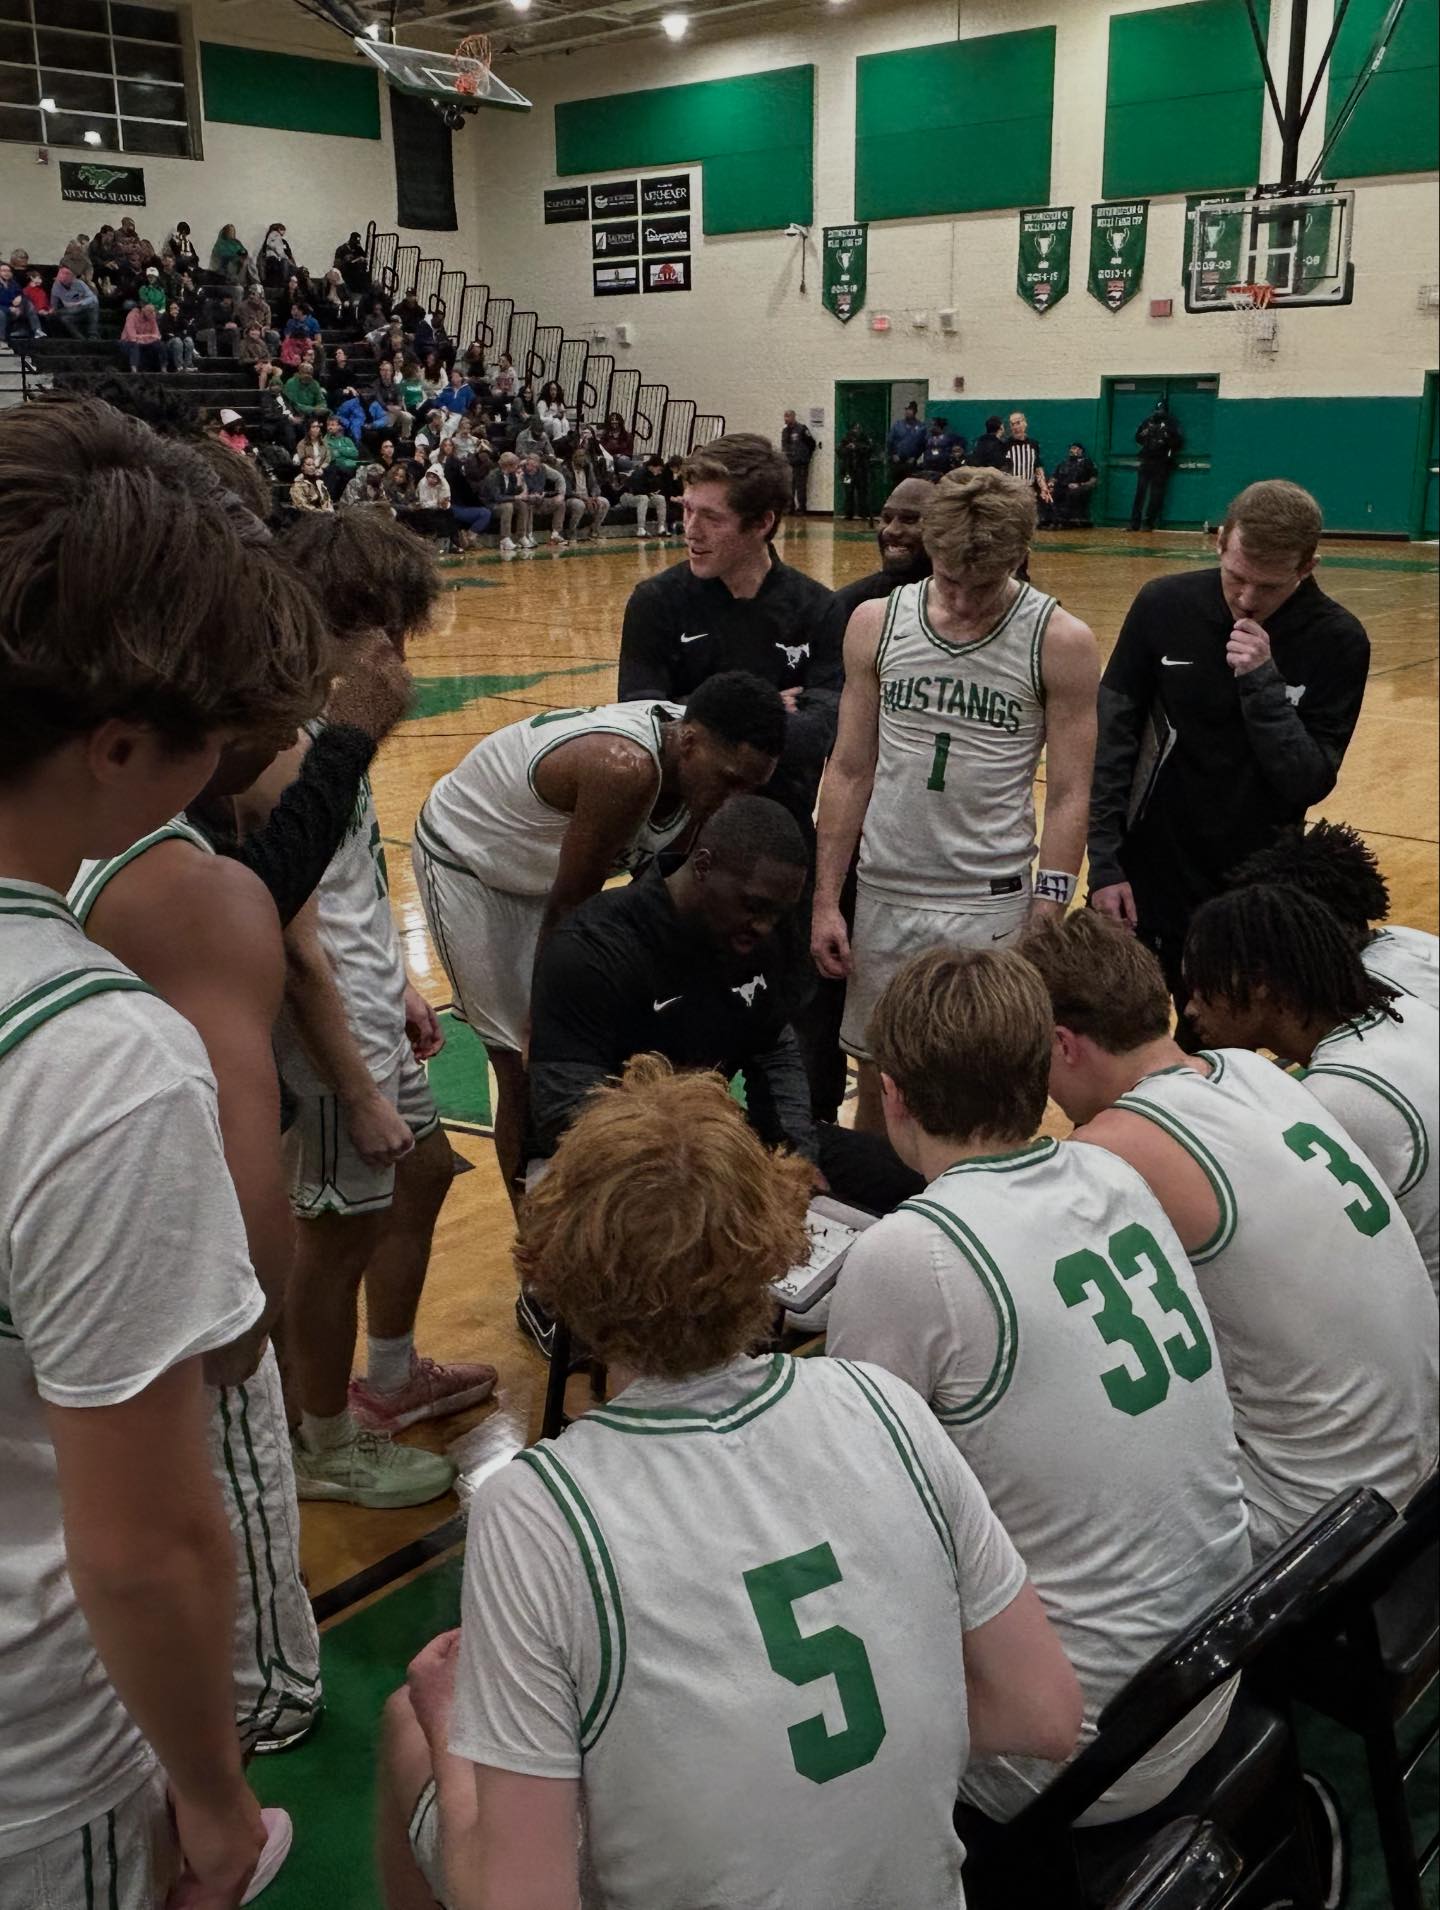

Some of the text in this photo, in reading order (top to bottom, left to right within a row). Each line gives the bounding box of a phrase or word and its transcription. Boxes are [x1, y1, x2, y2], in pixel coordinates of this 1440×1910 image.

[63, 189, 145, 202] MUSTANG SEATING
[1097, 269, 1133, 279] 2013-14
[882, 676, 1023, 734] MUSTANGS
[927, 732, 951, 792] 1
[1281, 1121, 1391, 1238] 3
[1053, 1222, 1212, 1417] 33
[742, 1541, 887, 1785] 5
